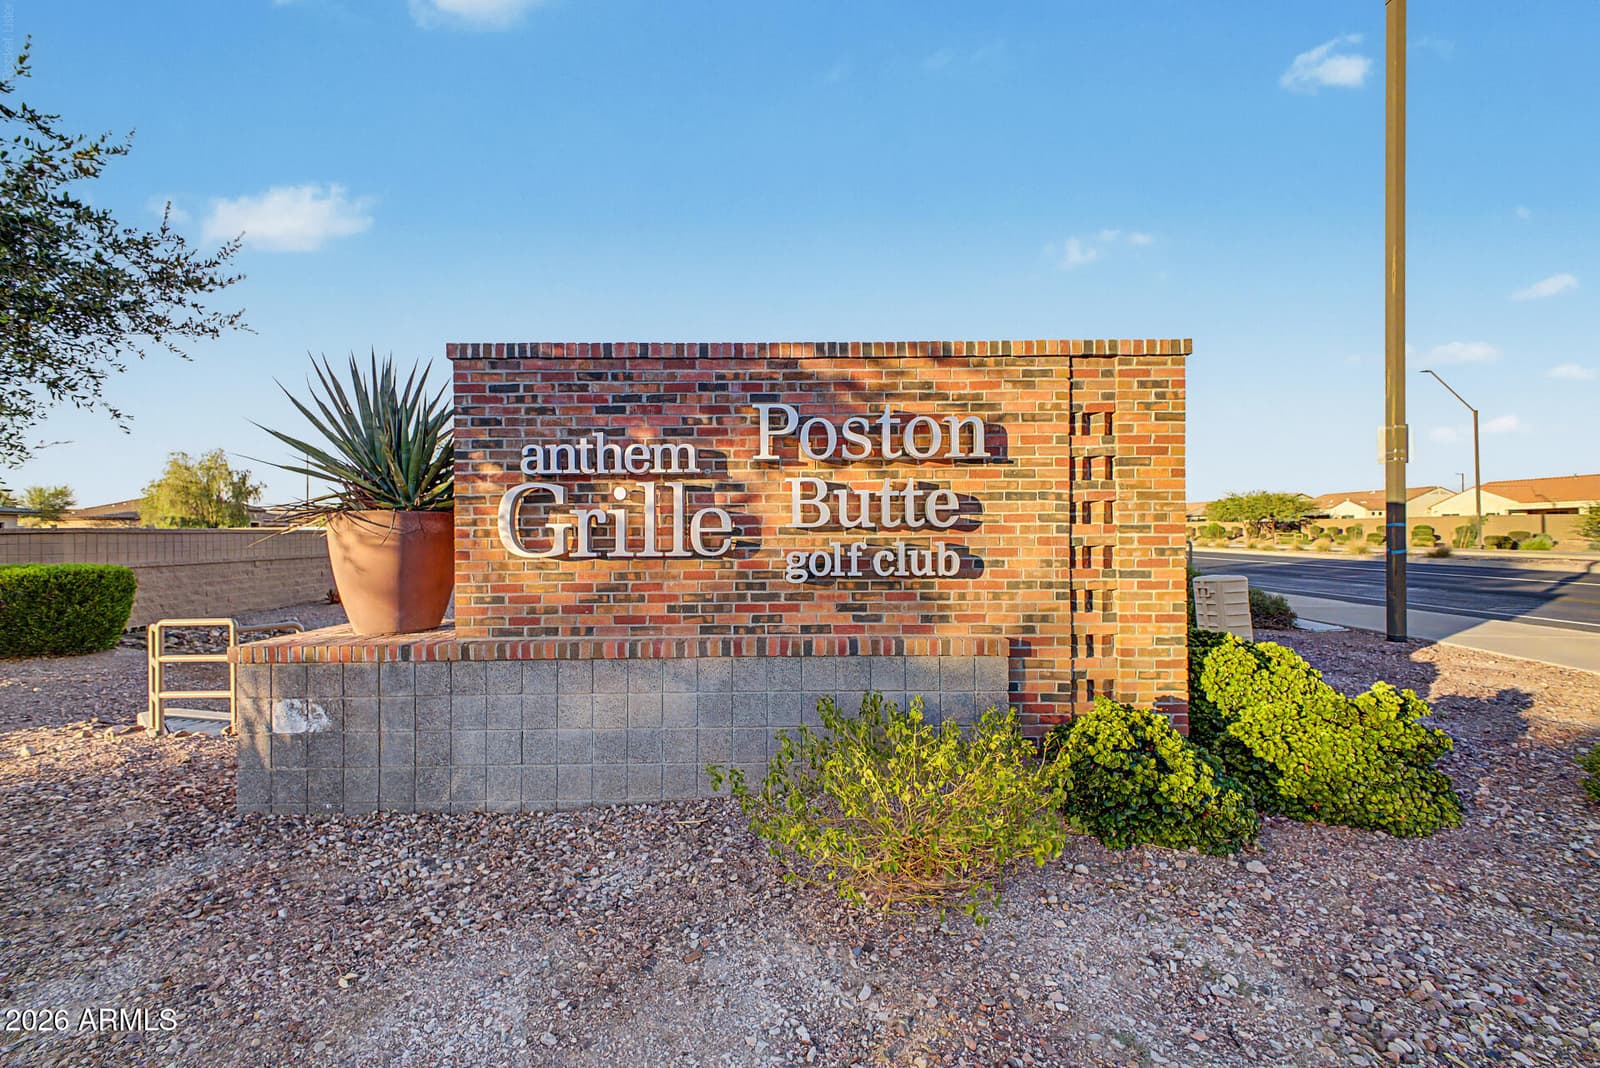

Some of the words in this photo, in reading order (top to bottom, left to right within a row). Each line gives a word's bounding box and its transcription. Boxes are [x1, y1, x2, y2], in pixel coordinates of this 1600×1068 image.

[520, 432, 701, 475] anthem
[752, 403, 991, 460] Poston
[497, 482, 732, 558] Grille
[785, 477, 960, 529] Butte
[785, 541, 867, 584] golf
[872, 541, 961, 577] club
